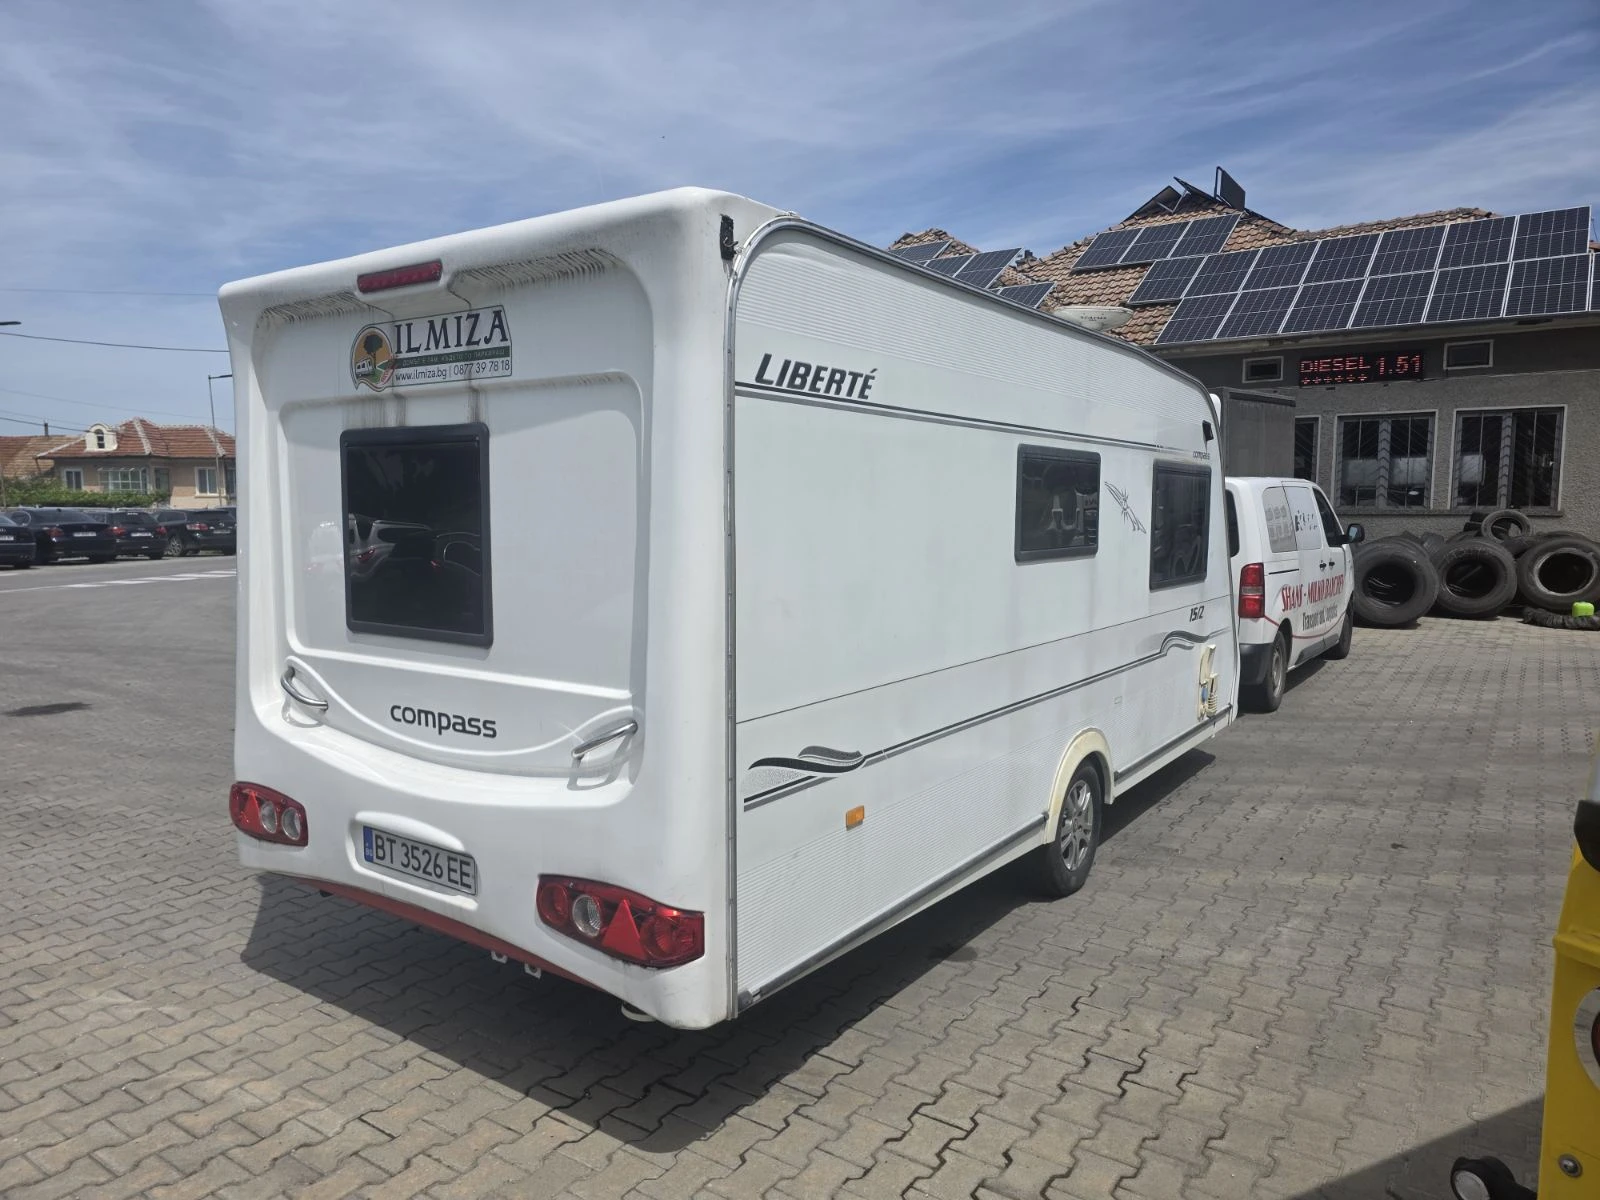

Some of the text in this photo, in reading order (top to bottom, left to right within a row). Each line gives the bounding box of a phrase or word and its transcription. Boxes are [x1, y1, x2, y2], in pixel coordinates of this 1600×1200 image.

[394, 309, 509, 354] ILMIZA
[395, 367, 447, 381] www.ilmiza.bg
[453, 363, 473, 376] 0877
[475, 362, 487, 374] 39
[488, 360, 499, 372] 78
[501, 359, 510, 371] 18
[754, 353, 878, 400] LIBERTÉ
[1300, 355, 1420, 374] DIESEL 1.51
[390, 704, 497, 738] compass
[374, 834, 472, 889] BT 3526 EE
